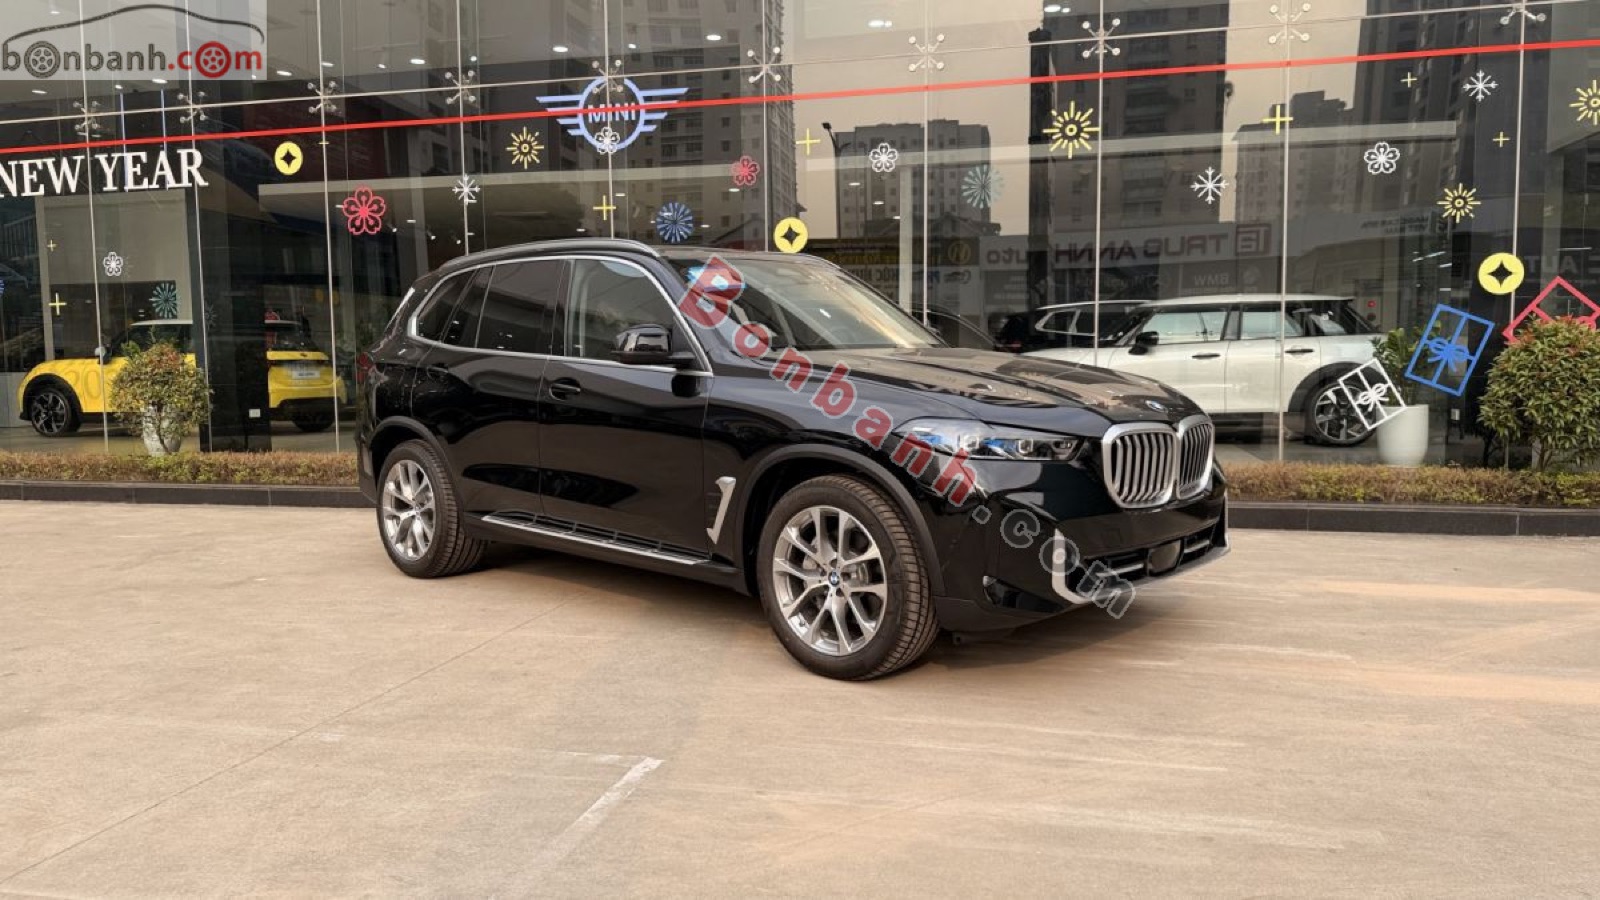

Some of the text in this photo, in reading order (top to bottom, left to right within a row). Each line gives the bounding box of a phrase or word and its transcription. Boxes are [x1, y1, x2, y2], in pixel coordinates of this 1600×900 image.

[588, 102, 636, 123] MINI
[0, 149, 209, 198] NEW YEAR
